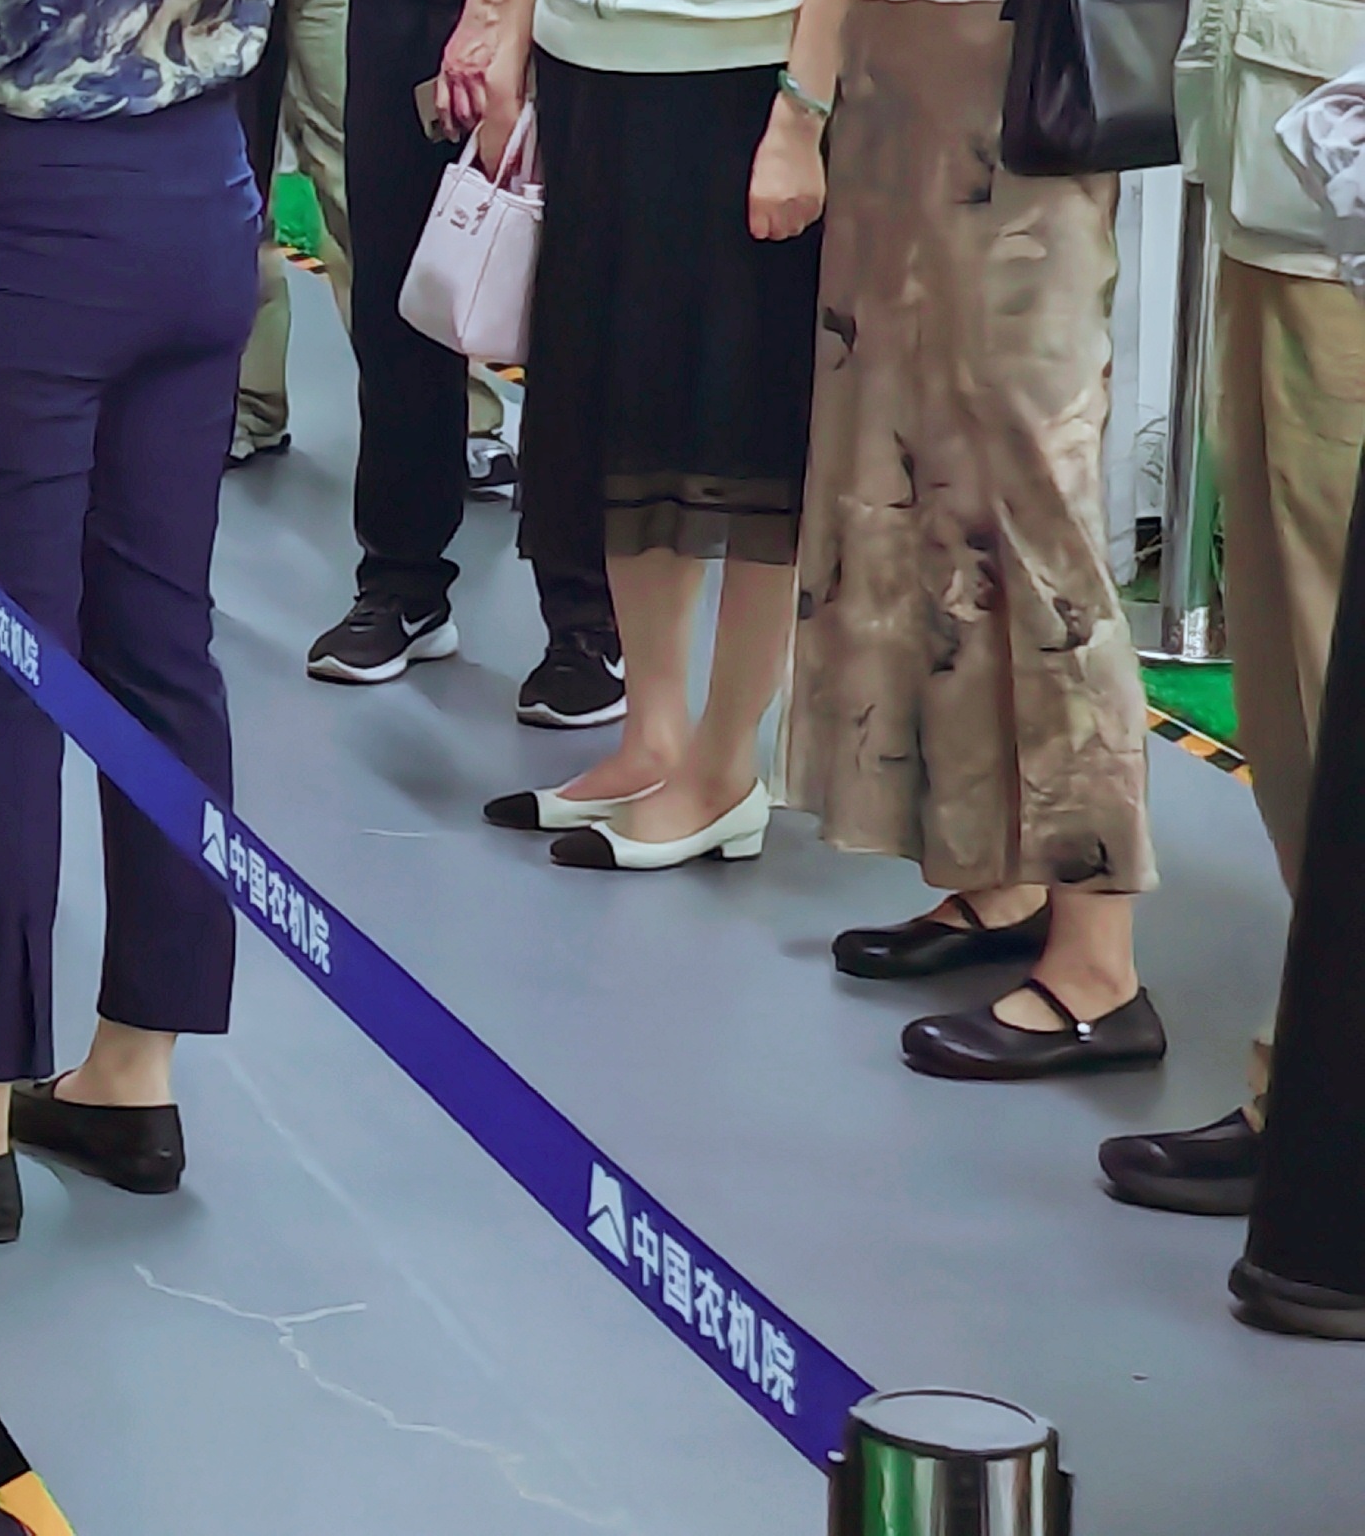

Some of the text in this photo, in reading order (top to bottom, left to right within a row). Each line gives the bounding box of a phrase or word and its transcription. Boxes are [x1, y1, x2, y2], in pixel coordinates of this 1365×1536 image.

[229, 832, 331, 974] 中国农机院
[632, 1212, 796, 1415] 中国农机院
